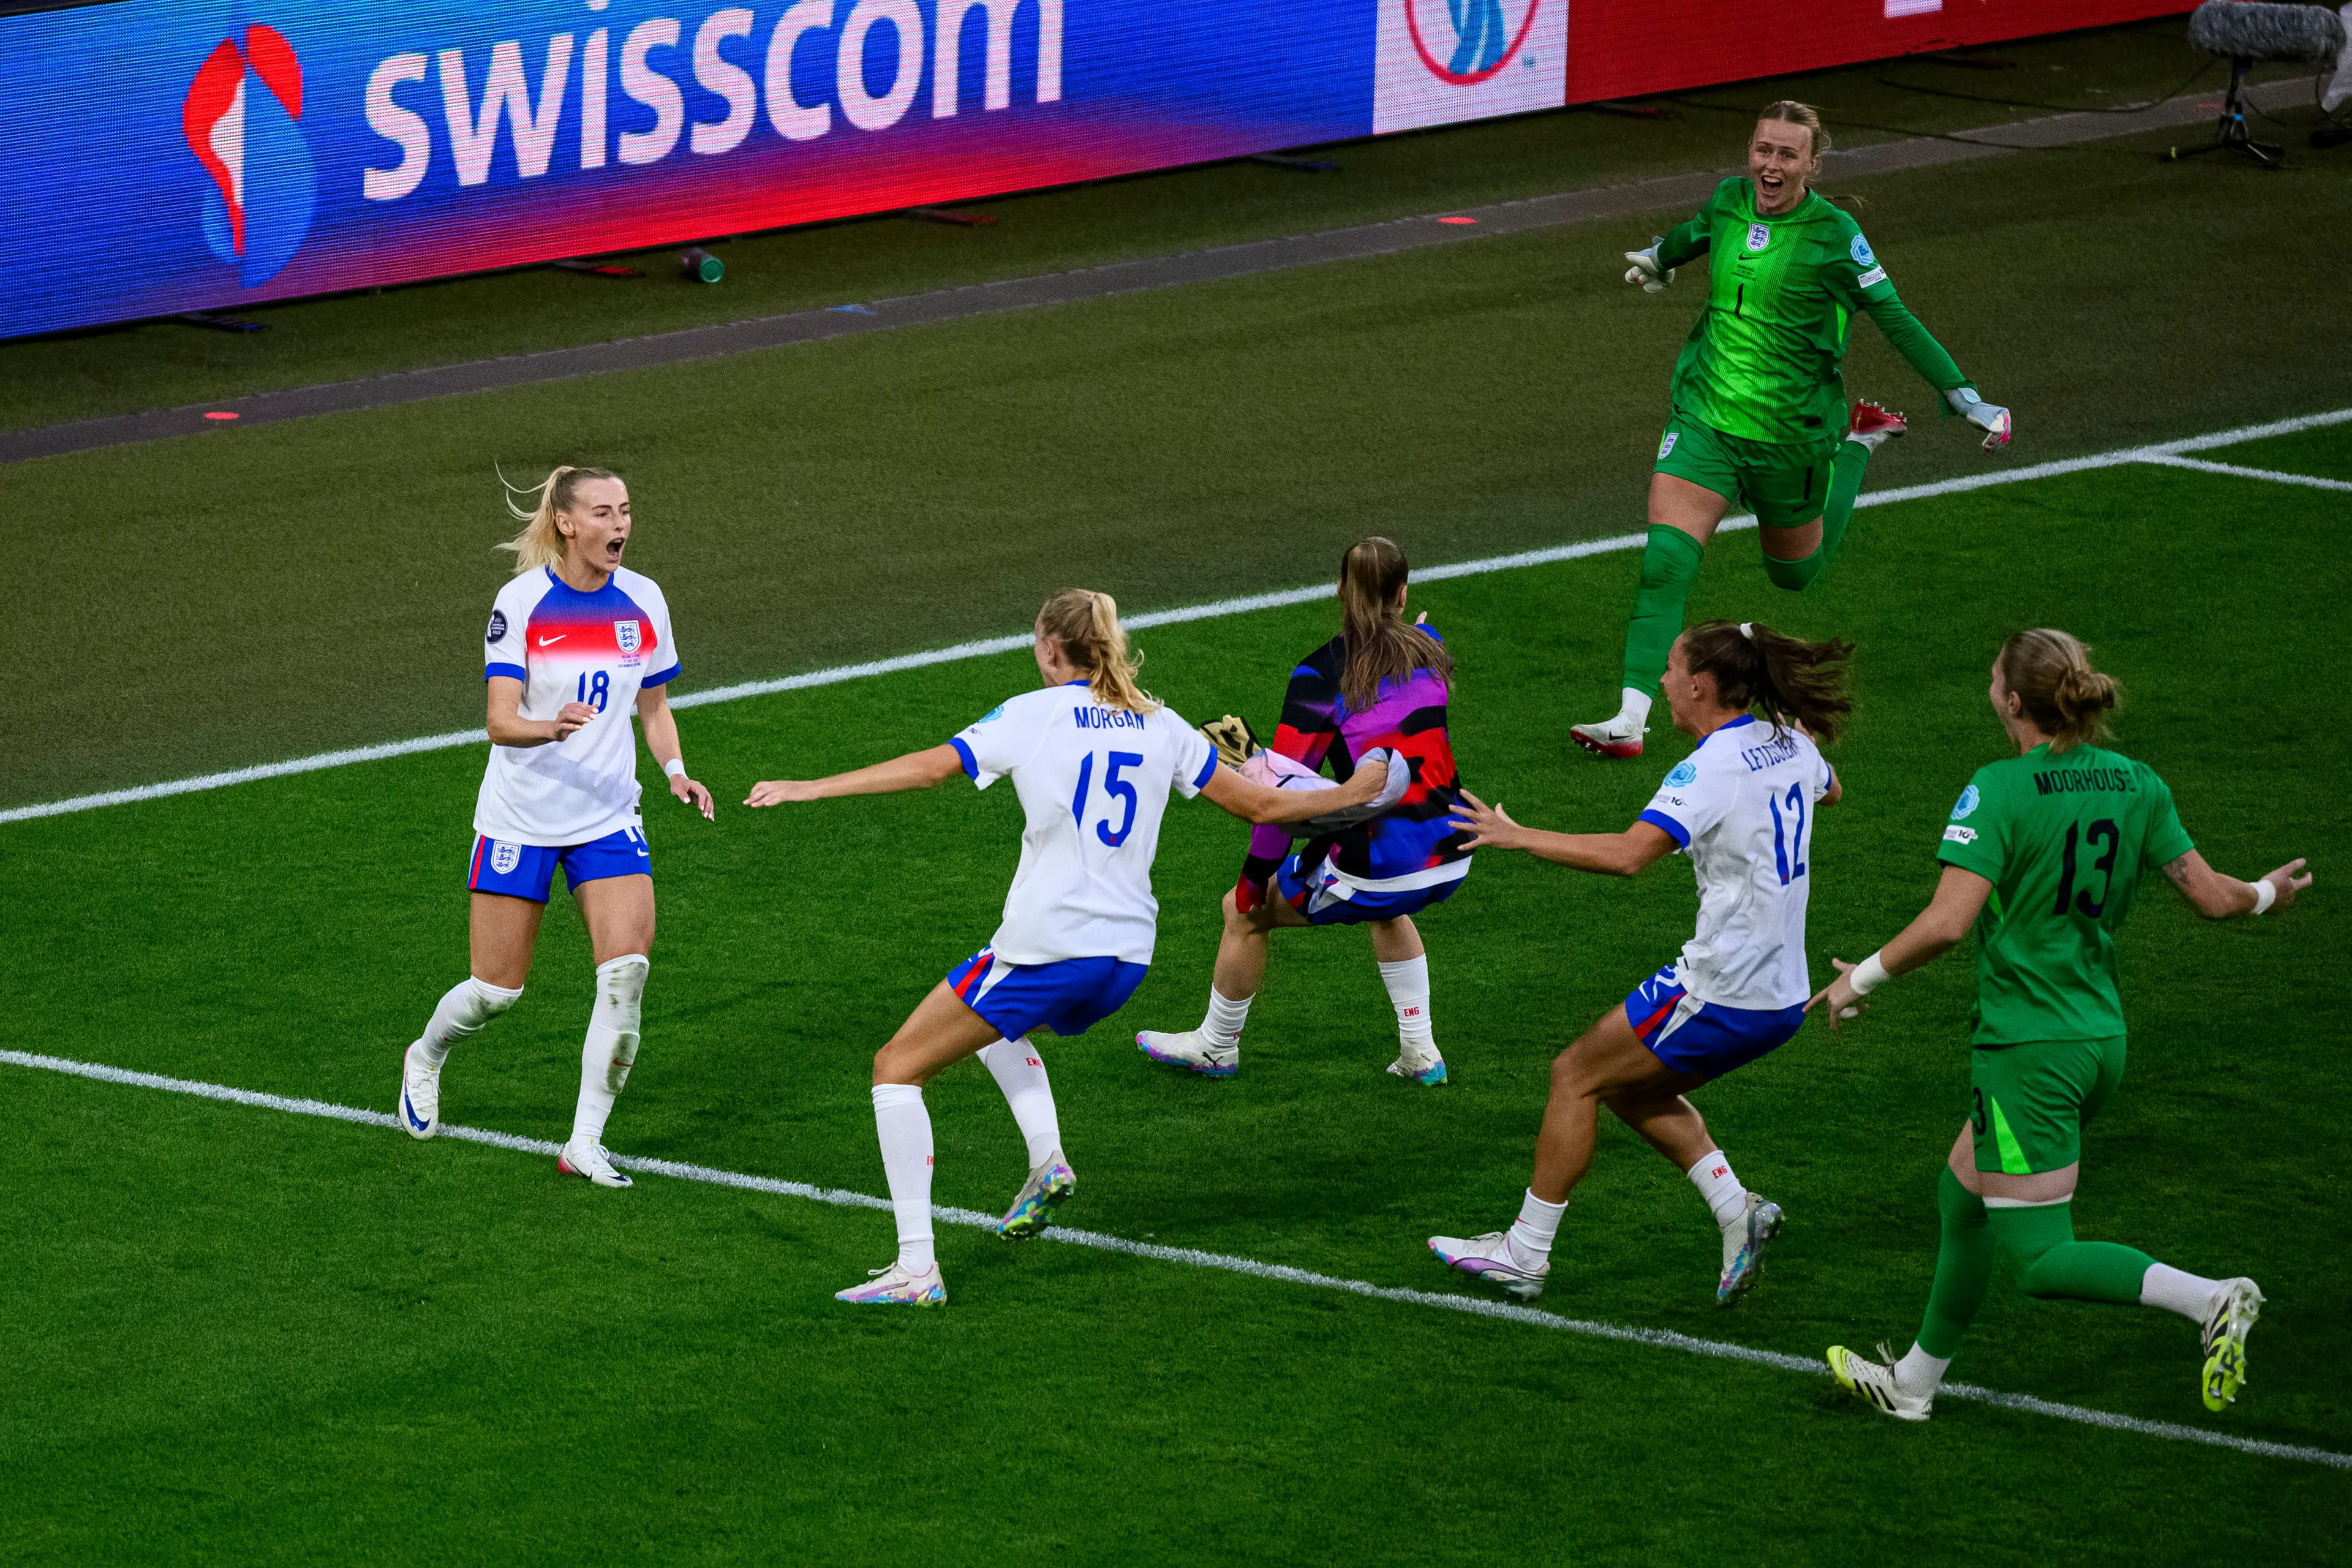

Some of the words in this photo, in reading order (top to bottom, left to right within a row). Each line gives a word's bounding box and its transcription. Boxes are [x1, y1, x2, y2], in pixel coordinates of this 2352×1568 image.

[363, 0, 1061, 200] swisscom
[1734, 282, 1744, 320] 1
[577, 669, 609, 714] 18
[1074, 706, 1144, 730] MORGAN
[1072, 750, 1143, 848] 15
[2033, 767, 2136, 796] MOORHOUSE
[1769, 781, 1806, 886] 12
[2052, 818, 2120, 918] 13
[1404, 1006, 1420, 1017] ENG
[1025, 1057, 1042, 1068] ENG
[1711, 1165, 1728, 1179] ENG
